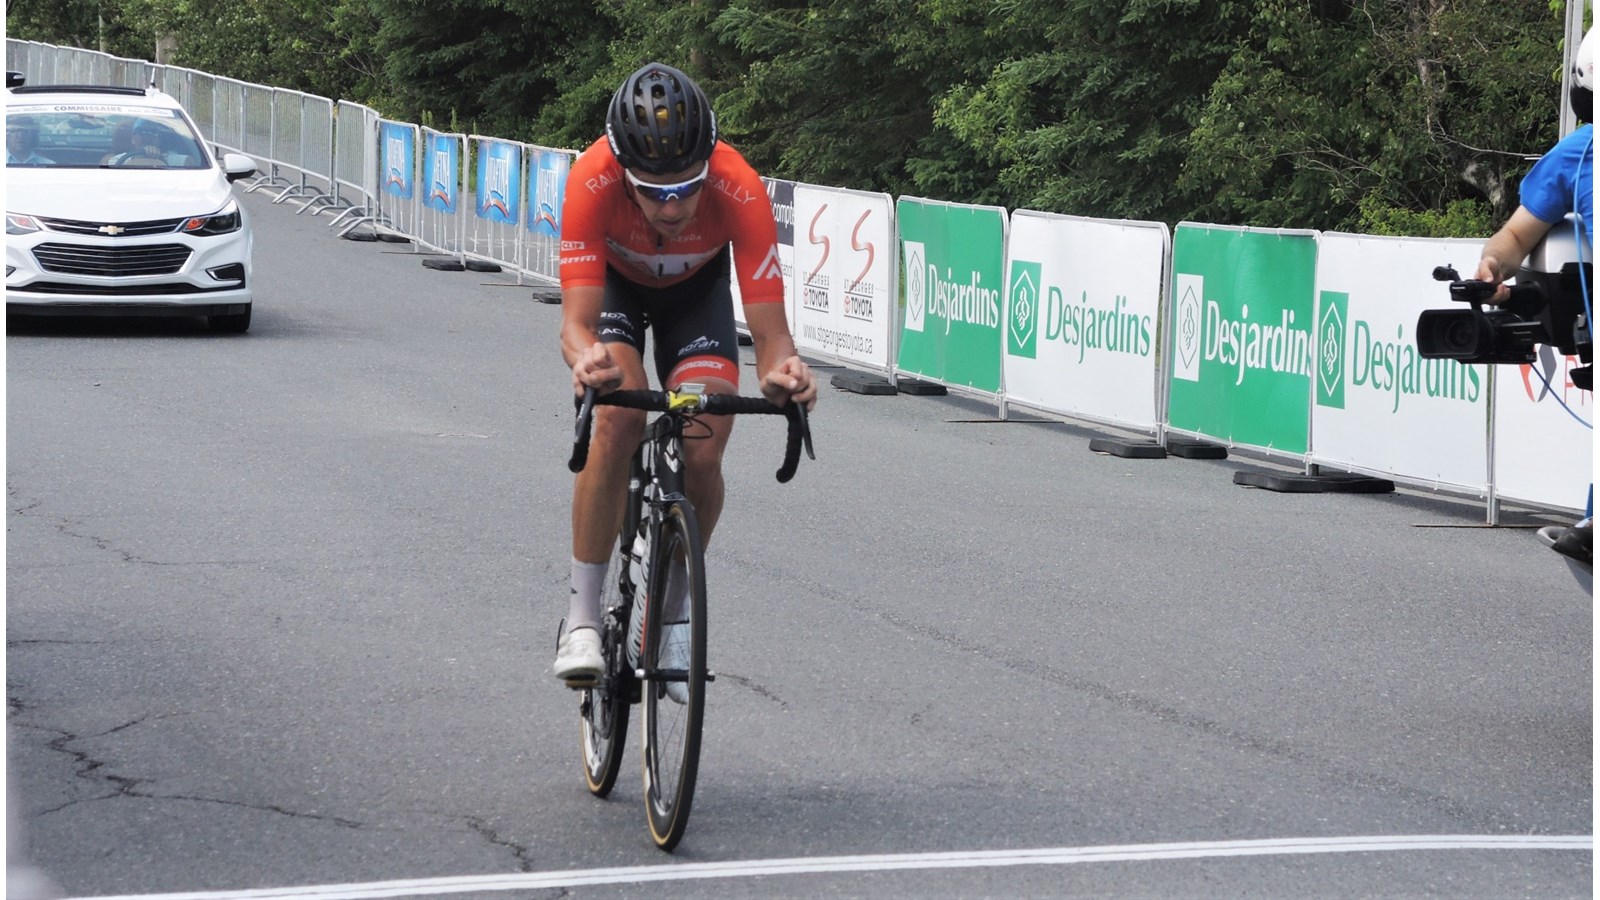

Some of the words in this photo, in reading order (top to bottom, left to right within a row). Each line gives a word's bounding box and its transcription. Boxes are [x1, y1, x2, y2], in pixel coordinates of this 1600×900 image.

[705, 174, 757, 204] RALLY
[808, 288, 830, 309] TOYOTA
[851, 296, 874, 318] TOYOTA
[928, 263, 999, 336] Desjardins
[803, 324, 873, 356] www.stgeorgestoyota.ca
[1045, 285, 1151, 365] Desjardins
